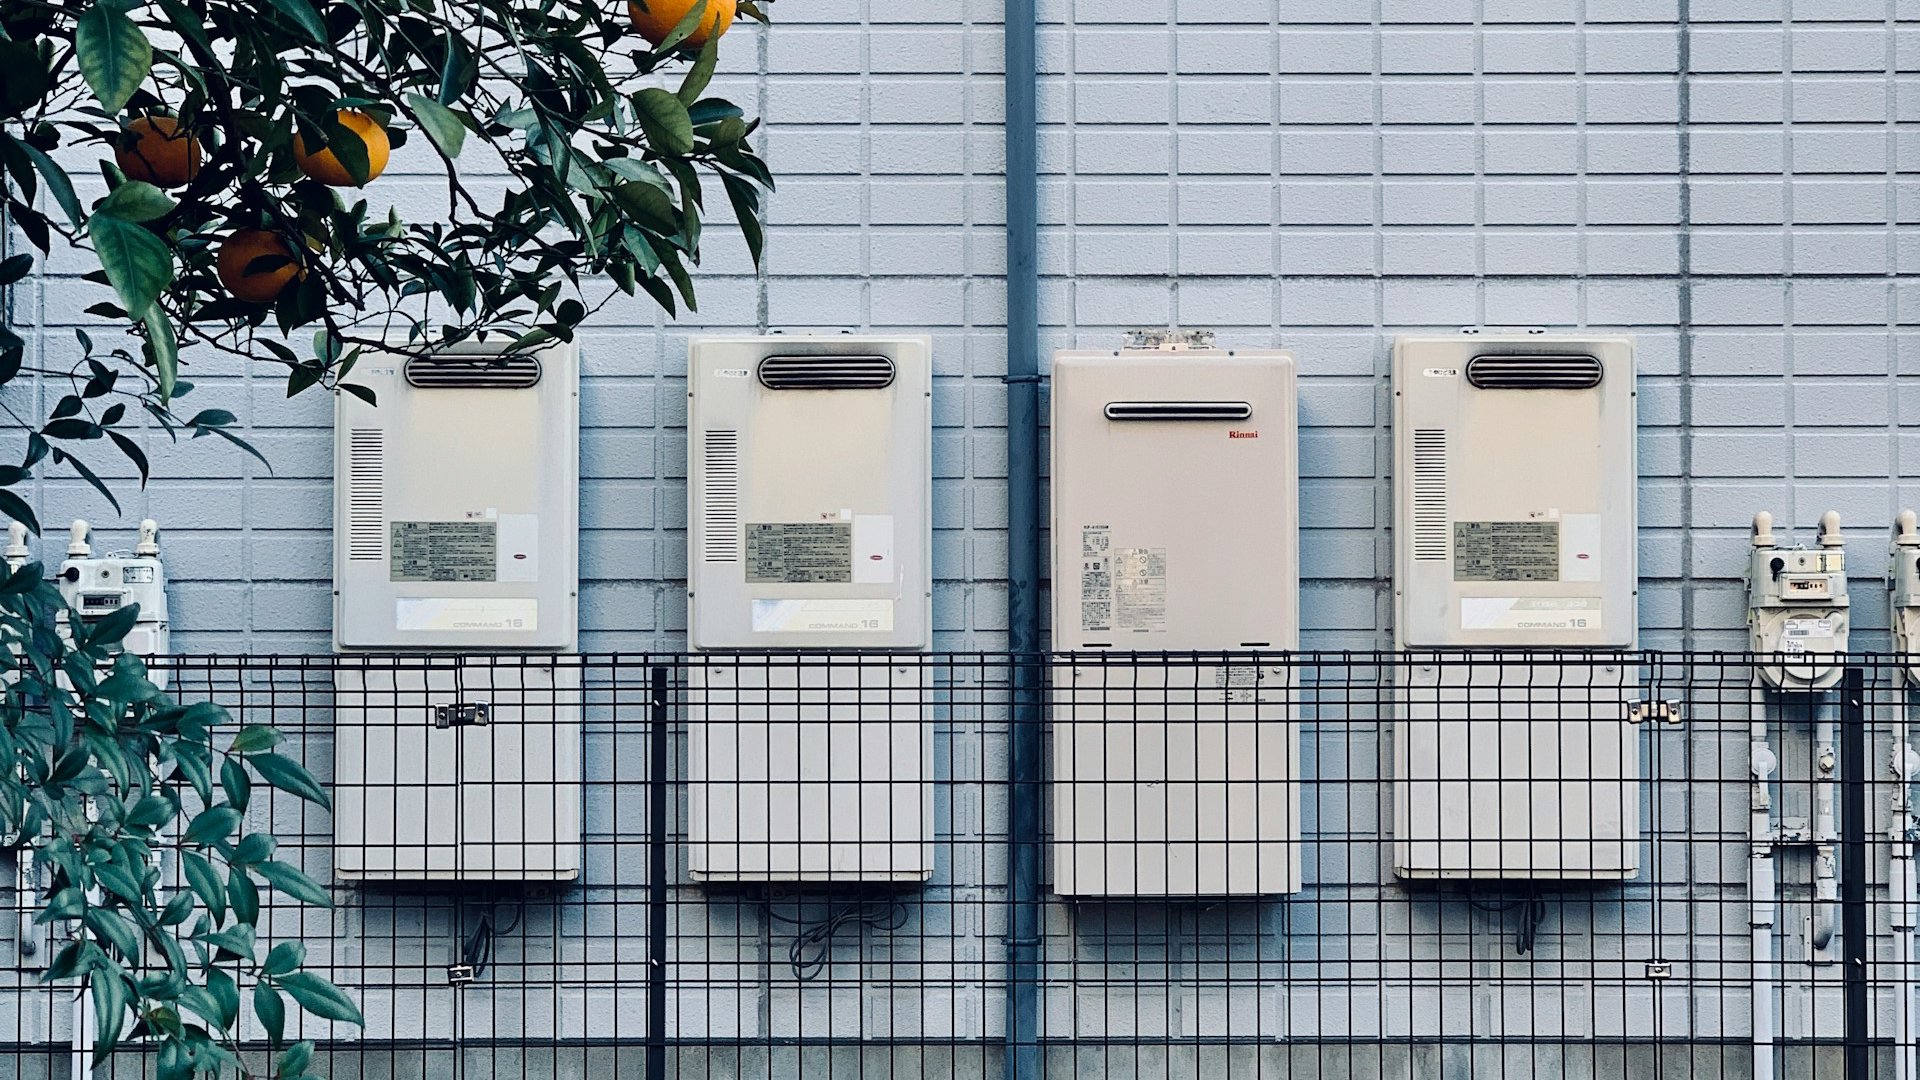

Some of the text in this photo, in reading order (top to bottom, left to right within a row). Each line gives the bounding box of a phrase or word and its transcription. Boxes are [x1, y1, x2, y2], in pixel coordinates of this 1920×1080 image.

[1229, 430, 1258, 438] Rinnai
[505, 618, 523, 628] 16
[861, 619, 879, 628] 16
[1569, 618, 1586, 628] 16
